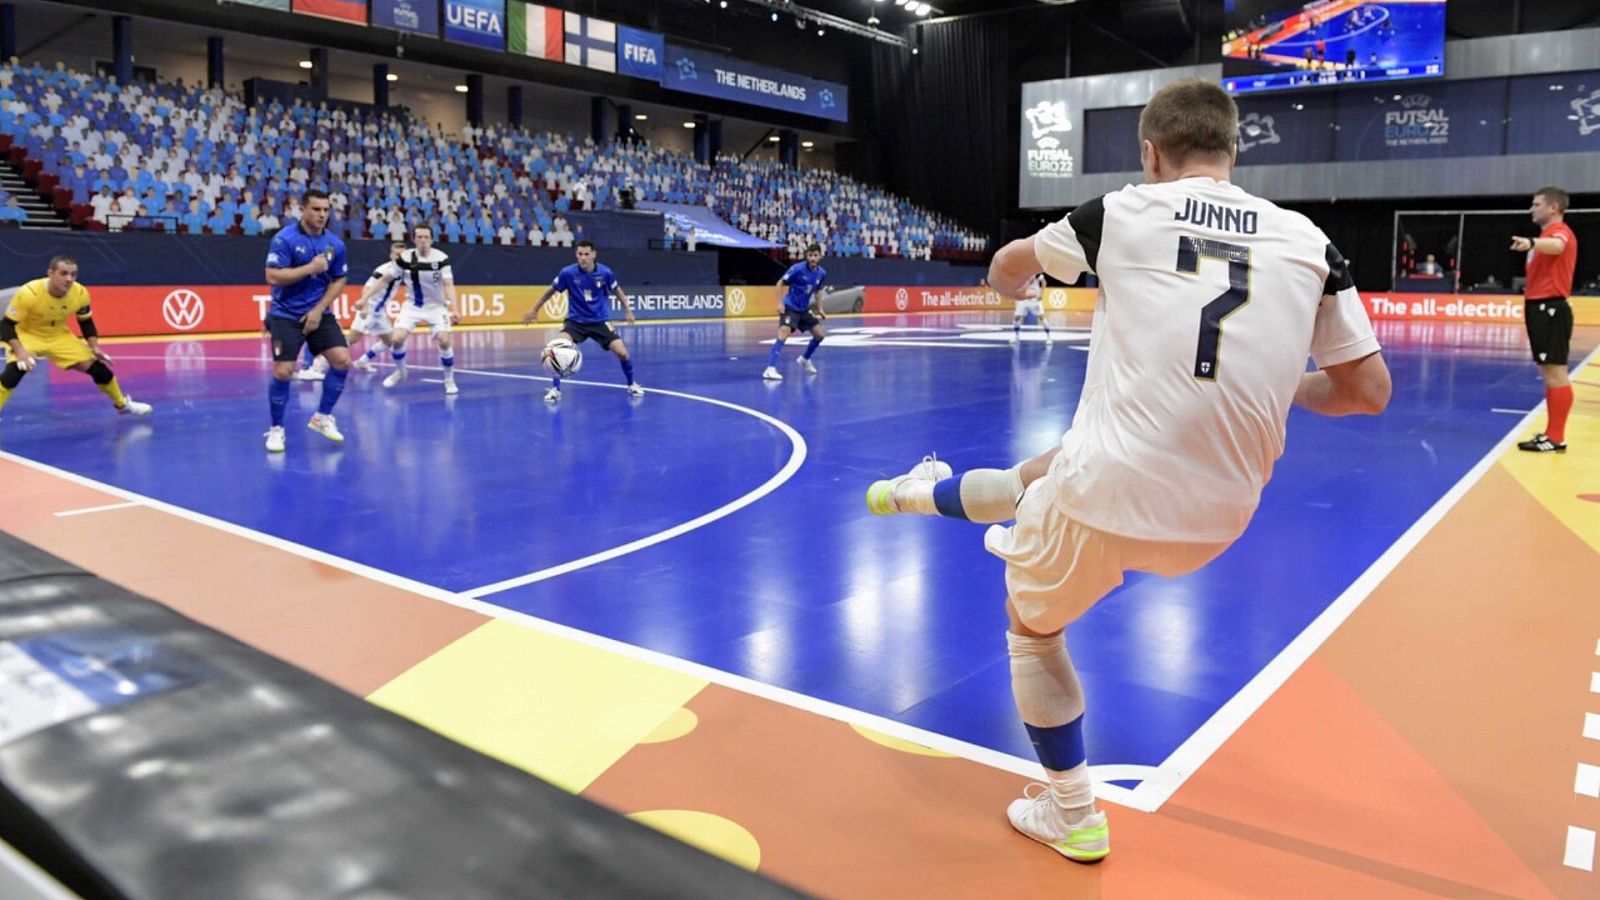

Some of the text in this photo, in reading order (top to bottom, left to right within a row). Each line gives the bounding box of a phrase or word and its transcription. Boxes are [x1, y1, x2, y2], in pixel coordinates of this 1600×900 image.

[447, 3, 501, 33] UEFA
[624, 43, 657, 65] FIFA
[715, 69, 807, 101] THE NETHERLANDS
[1385, 109, 1449, 125] FUTSAL
[1027, 148, 1073, 161] FUTSAL
[1028, 160, 1059, 173] EURO
[1174, 197, 1258, 235] JUNNO
[461, 293, 505, 317] ID.5
[638, 294, 724, 310] NETHERLANDS
[921, 291, 938, 306] The
[940, 290, 985, 306] all-electric
[1371, 298, 1523, 318] The all-electric
[1176, 236, 1252, 382] 7
